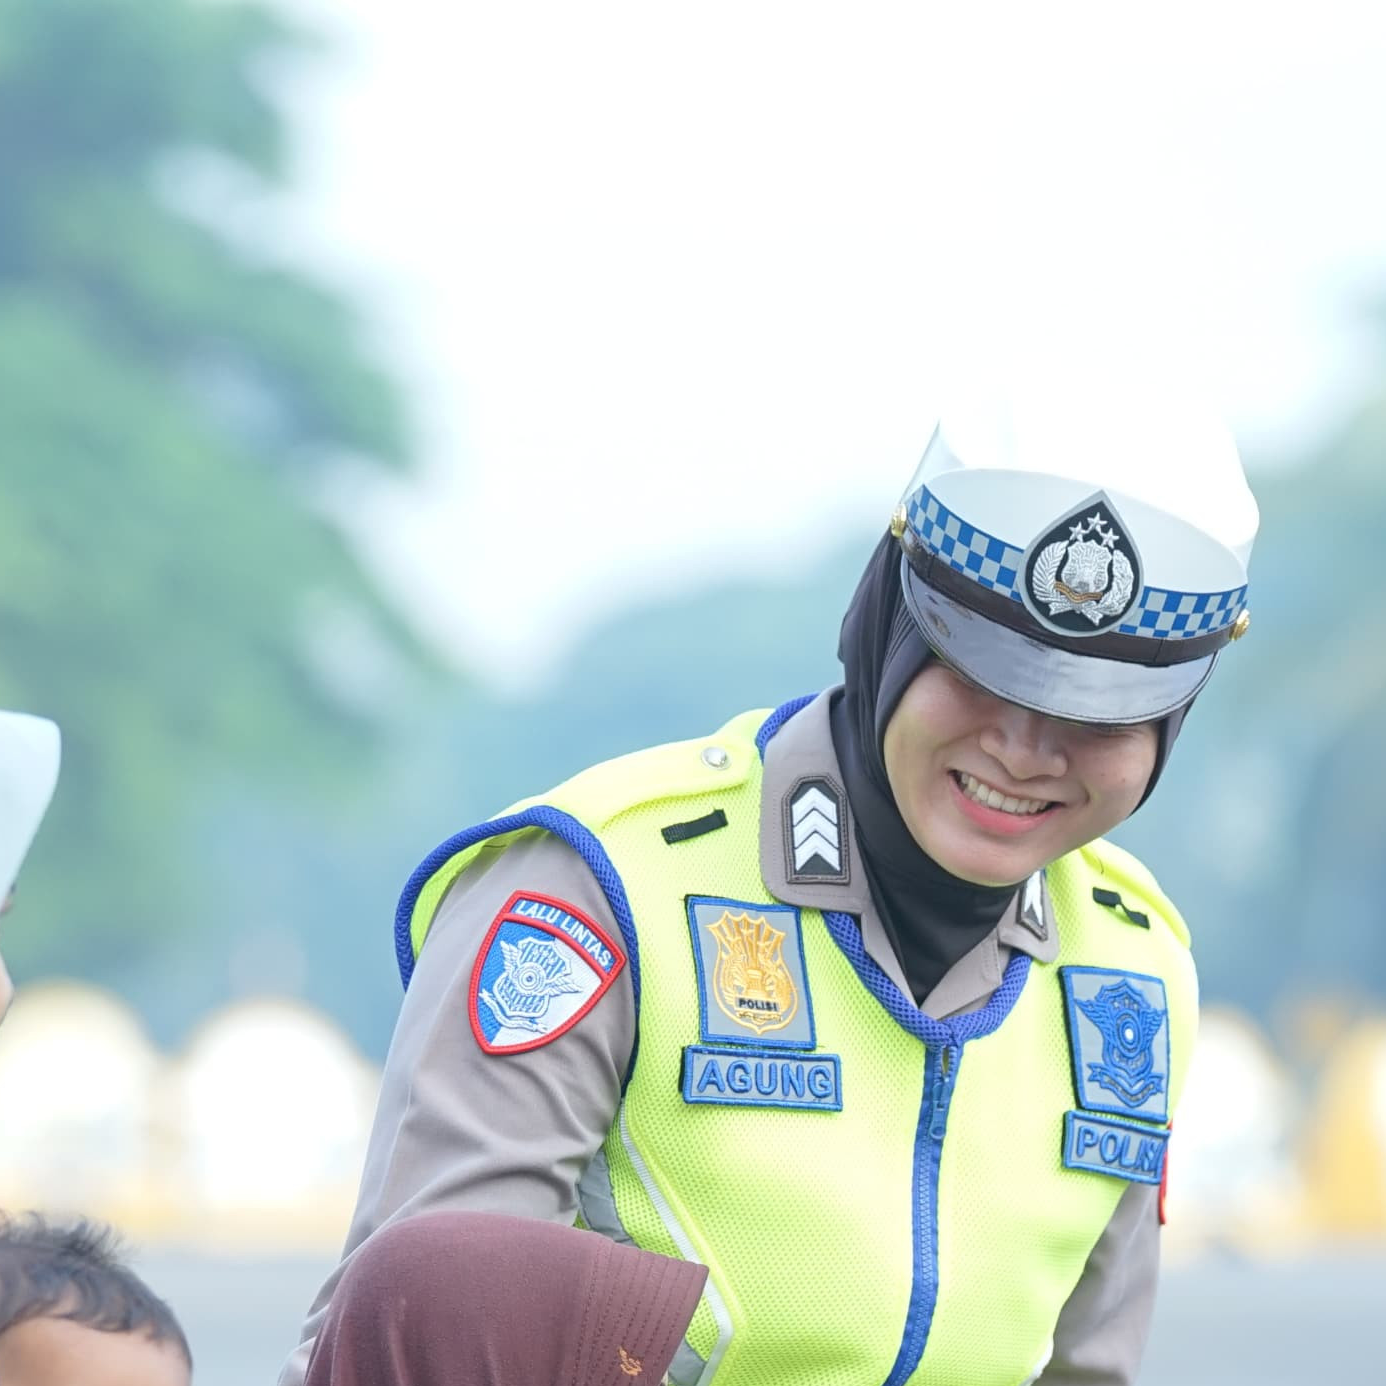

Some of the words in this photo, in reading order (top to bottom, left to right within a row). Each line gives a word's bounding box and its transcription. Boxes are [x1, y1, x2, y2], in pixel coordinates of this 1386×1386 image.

[515, 900, 561, 923] LALU
[560, 917, 611, 967] LINTAS
[738, 997, 778, 1012] POLISI
[697, 1059, 833, 1098] AGUNG
